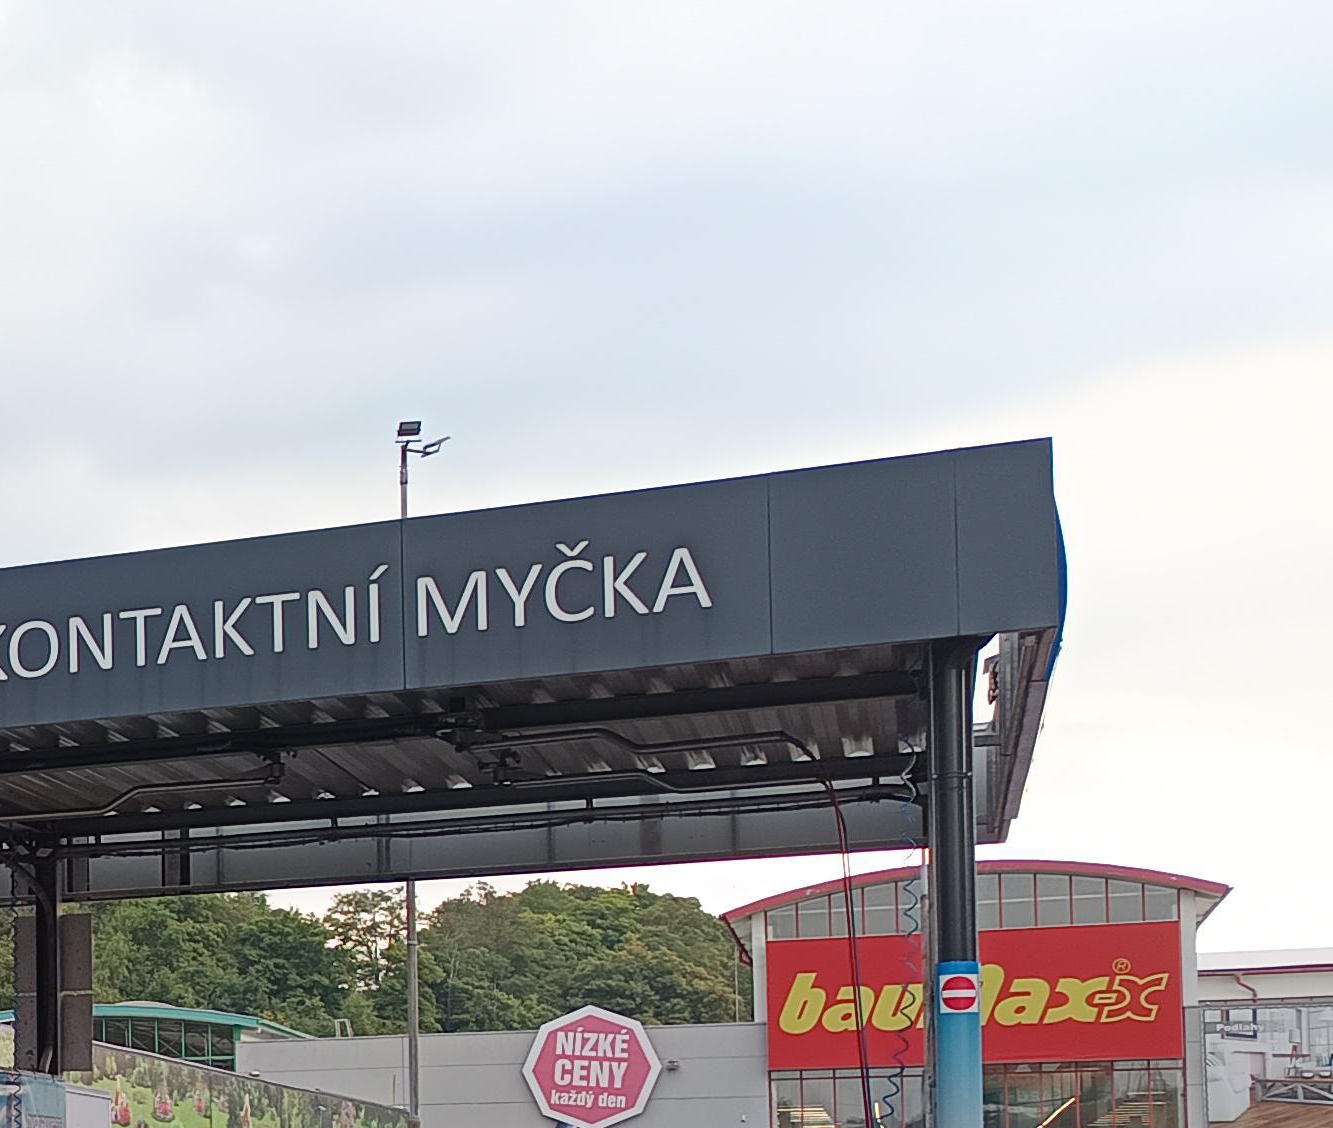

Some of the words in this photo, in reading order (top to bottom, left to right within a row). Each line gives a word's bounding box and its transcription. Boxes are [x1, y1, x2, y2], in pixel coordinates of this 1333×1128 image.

[415, 541, 714, 639] MYČKA
[555, 1026, 630, 1058] NÍZKÉ
[1216, 1023, 1265, 1033] Podlahy
[554, 1058, 628, 1088] CENY
[550, 1090, 595, 1108] každý
[598, 1092, 626, 1108] den
